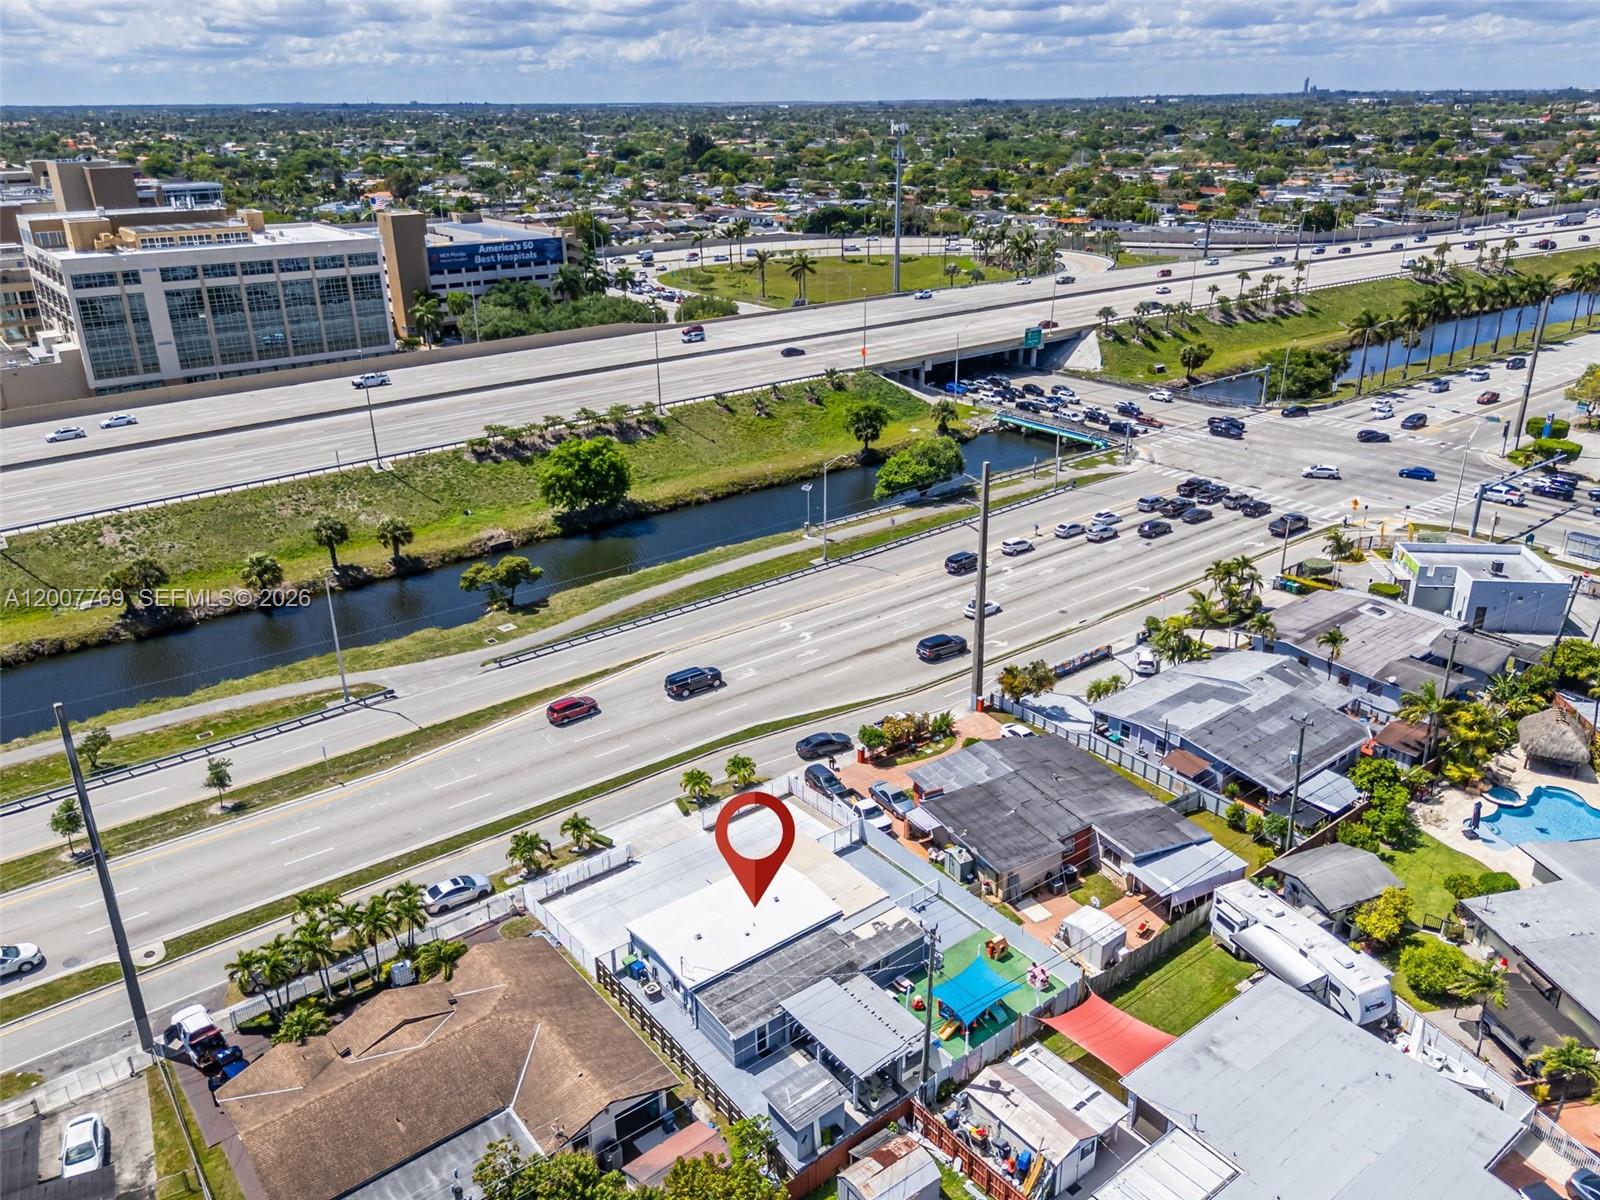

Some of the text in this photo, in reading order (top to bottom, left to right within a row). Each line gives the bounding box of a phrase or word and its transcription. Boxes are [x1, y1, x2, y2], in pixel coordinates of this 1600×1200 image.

[478, 241, 534, 254] America's 50
[474, 255, 496, 264] Best
[497, 251, 537, 263] Hospitals
